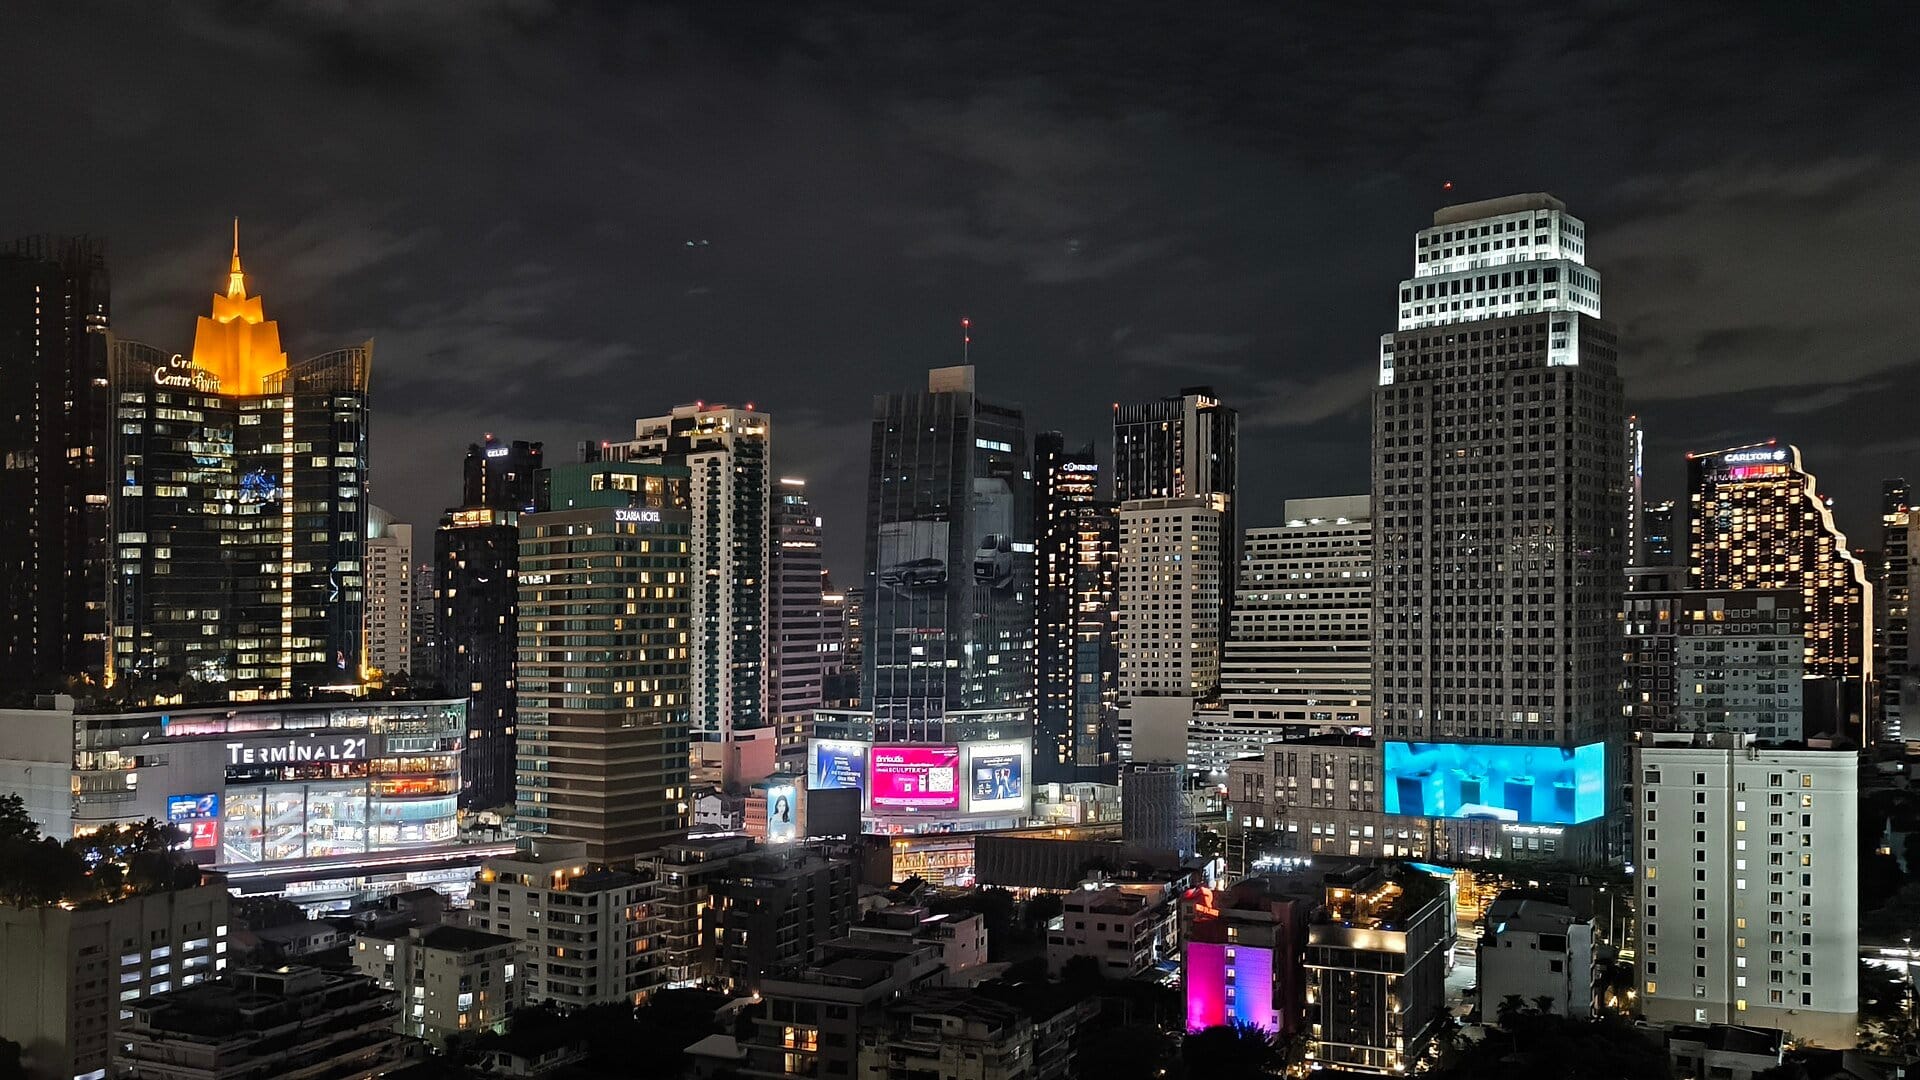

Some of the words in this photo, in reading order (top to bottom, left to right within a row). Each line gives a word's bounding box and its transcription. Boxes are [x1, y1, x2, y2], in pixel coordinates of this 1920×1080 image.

[154, 366, 191, 387] Centre
[1724, 452, 1772, 461] CARLTON
[615, 510, 640, 521] SOLARIA
[641, 511, 661, 522] HOTEL
[1502, 823, 1540, 835] Exchange
[1539, 825, 1564, 835] Tower
